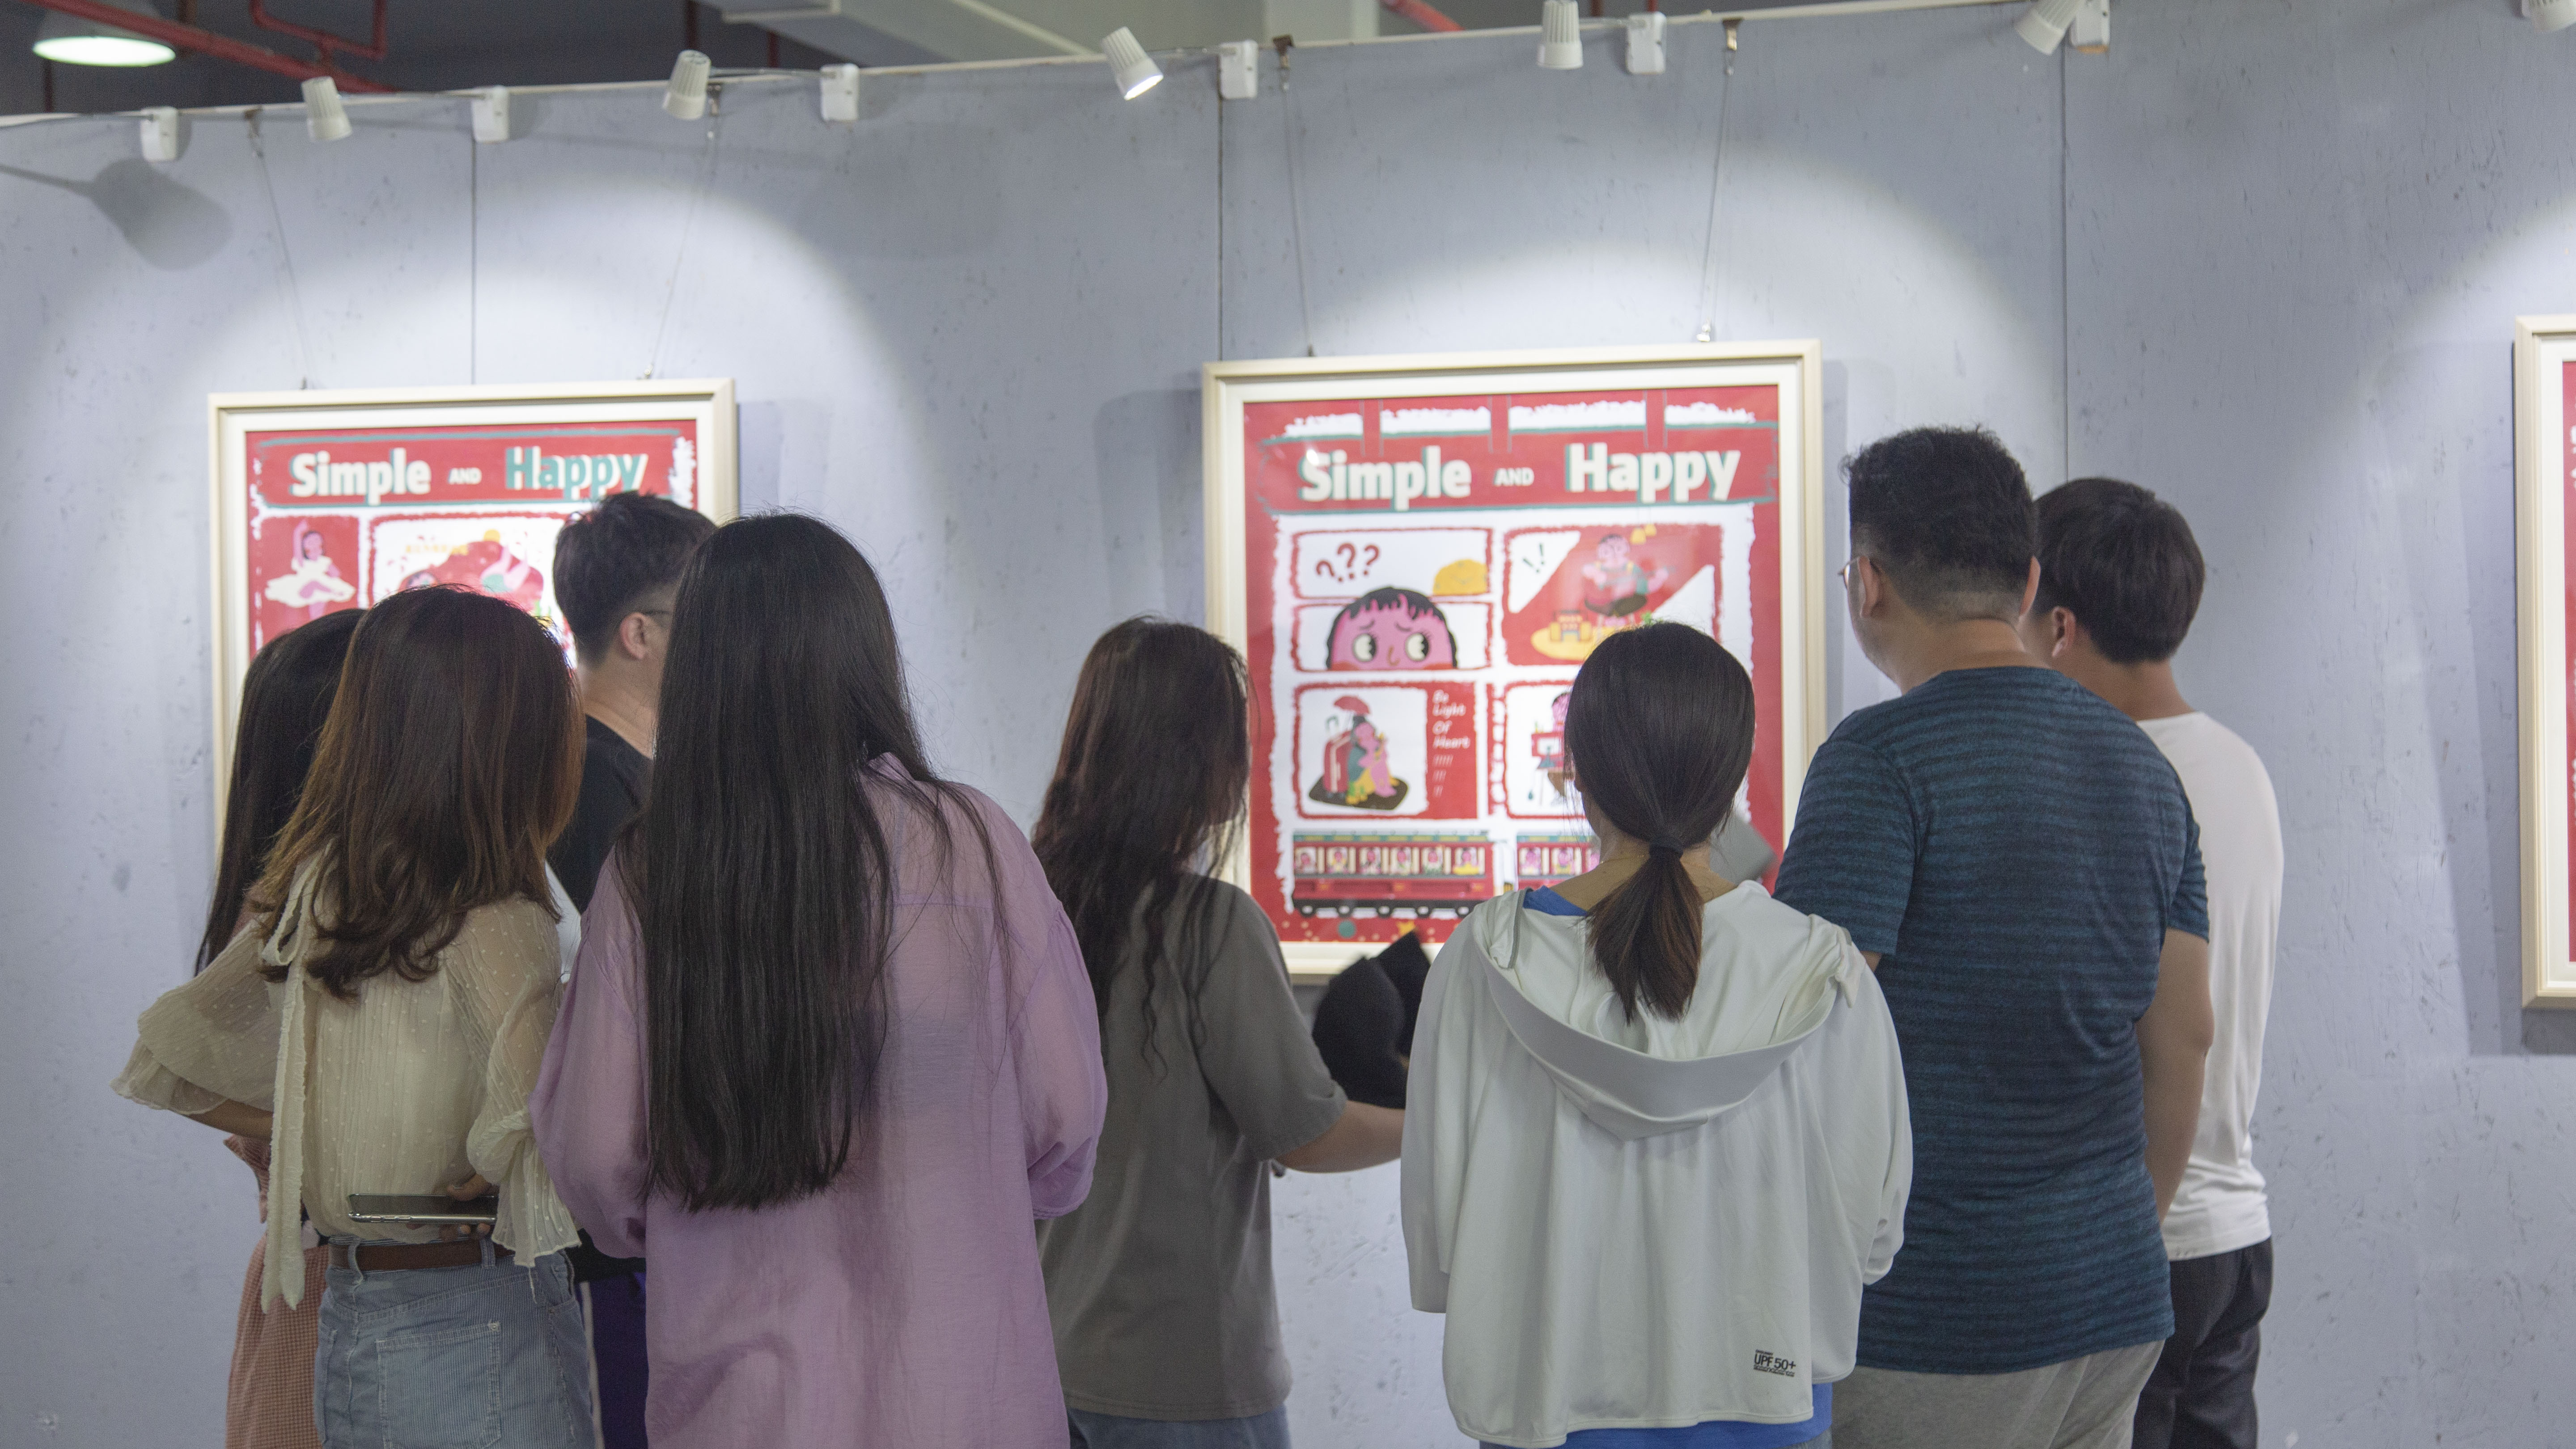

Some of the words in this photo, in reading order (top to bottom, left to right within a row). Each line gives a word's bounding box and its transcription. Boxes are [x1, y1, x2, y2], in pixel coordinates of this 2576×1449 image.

[290, 447, 431, 505] Simple
[448, 467, 482, 484] AND
[505, 445, 649, 501] Happy
[1299, 445, 1472, 511] Simple
[1493, 467, 1535, 486] AND
[1566, 442, 1741, 504] Happy
[1432, 702, 1466, 719] Light
[1432, 735, 1471, 749] Heart
[1754, 1353, 1774, 1367] UPF
[1774, 1357, 1796, 1370] 50+
